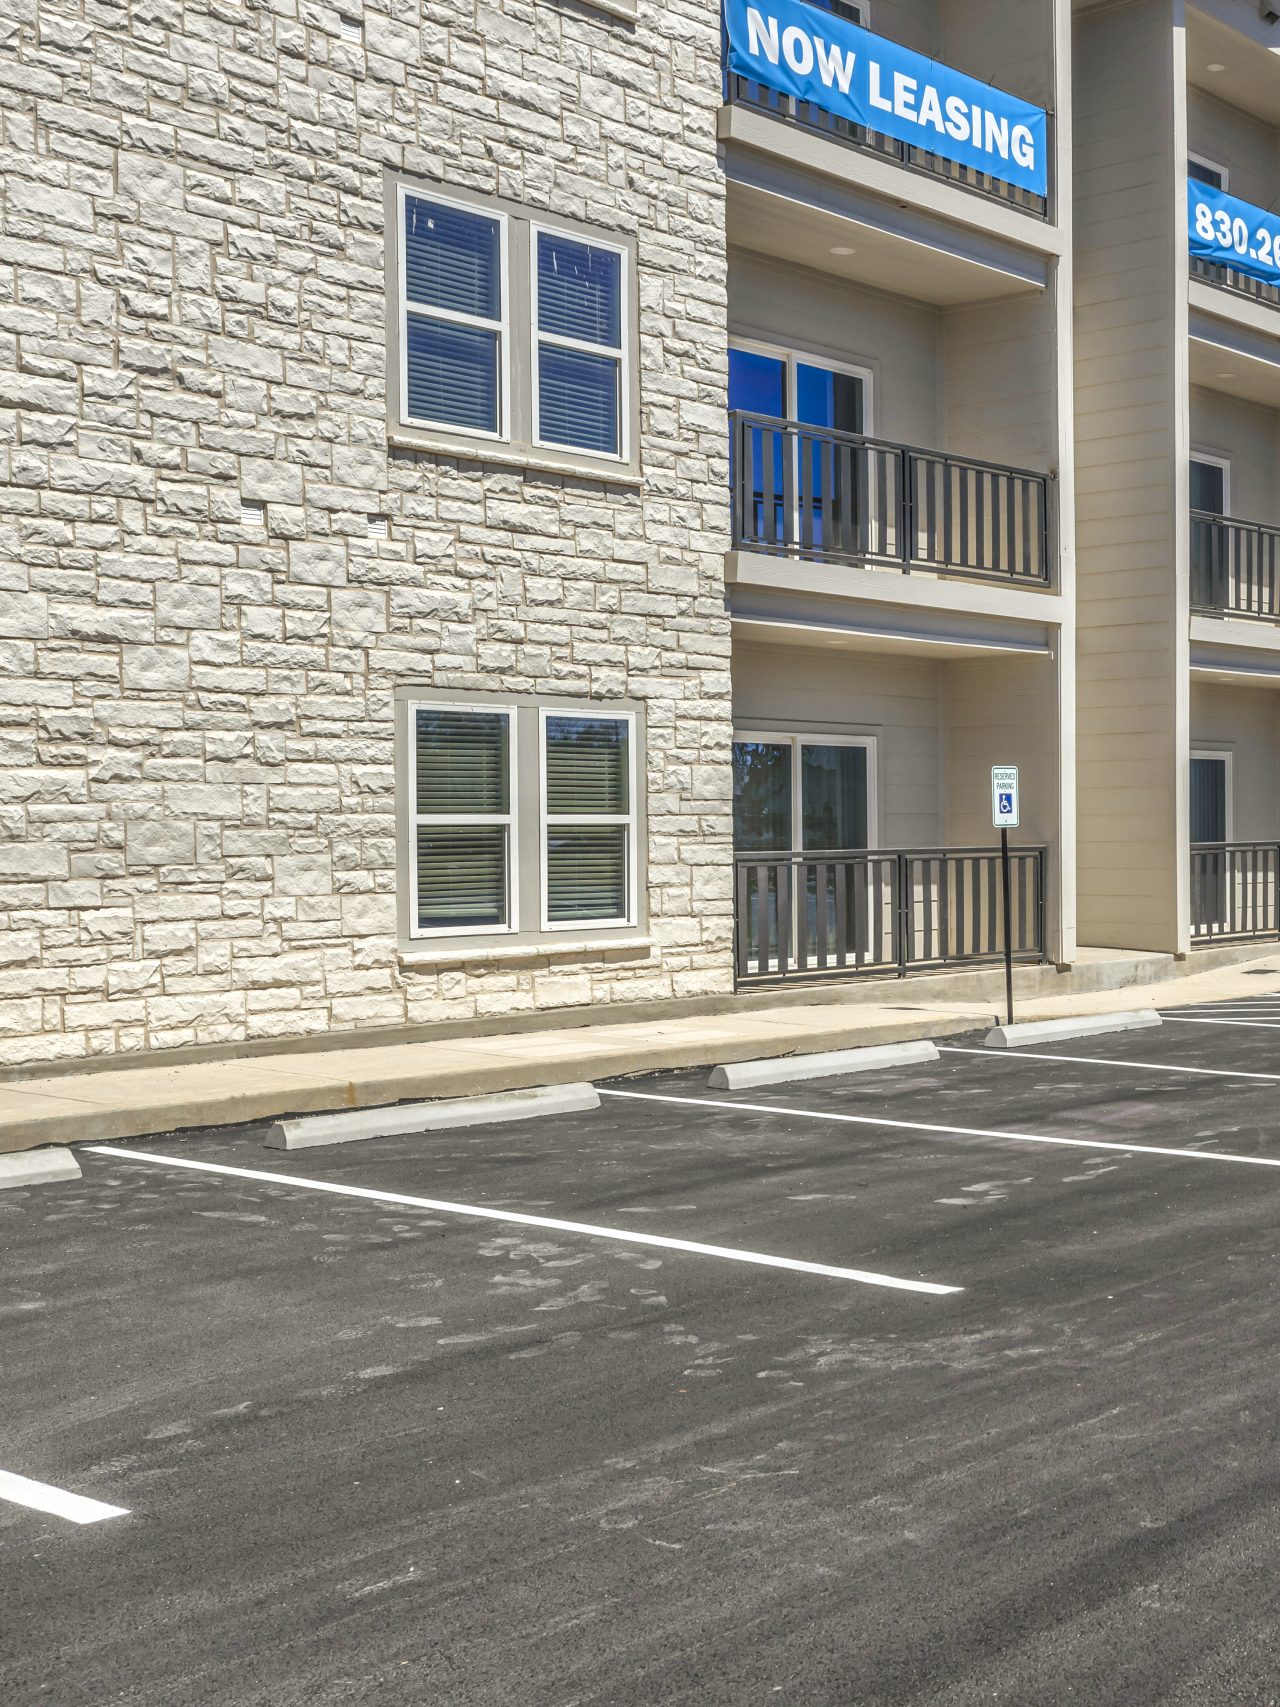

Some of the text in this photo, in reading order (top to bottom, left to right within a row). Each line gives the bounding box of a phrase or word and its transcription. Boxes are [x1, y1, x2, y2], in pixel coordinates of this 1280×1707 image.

[747, 7, 1035, 170] NOW LEASING
[994, 772, 1016, 781] RESERVED
[996, 782, 1015, 790] PARKING
